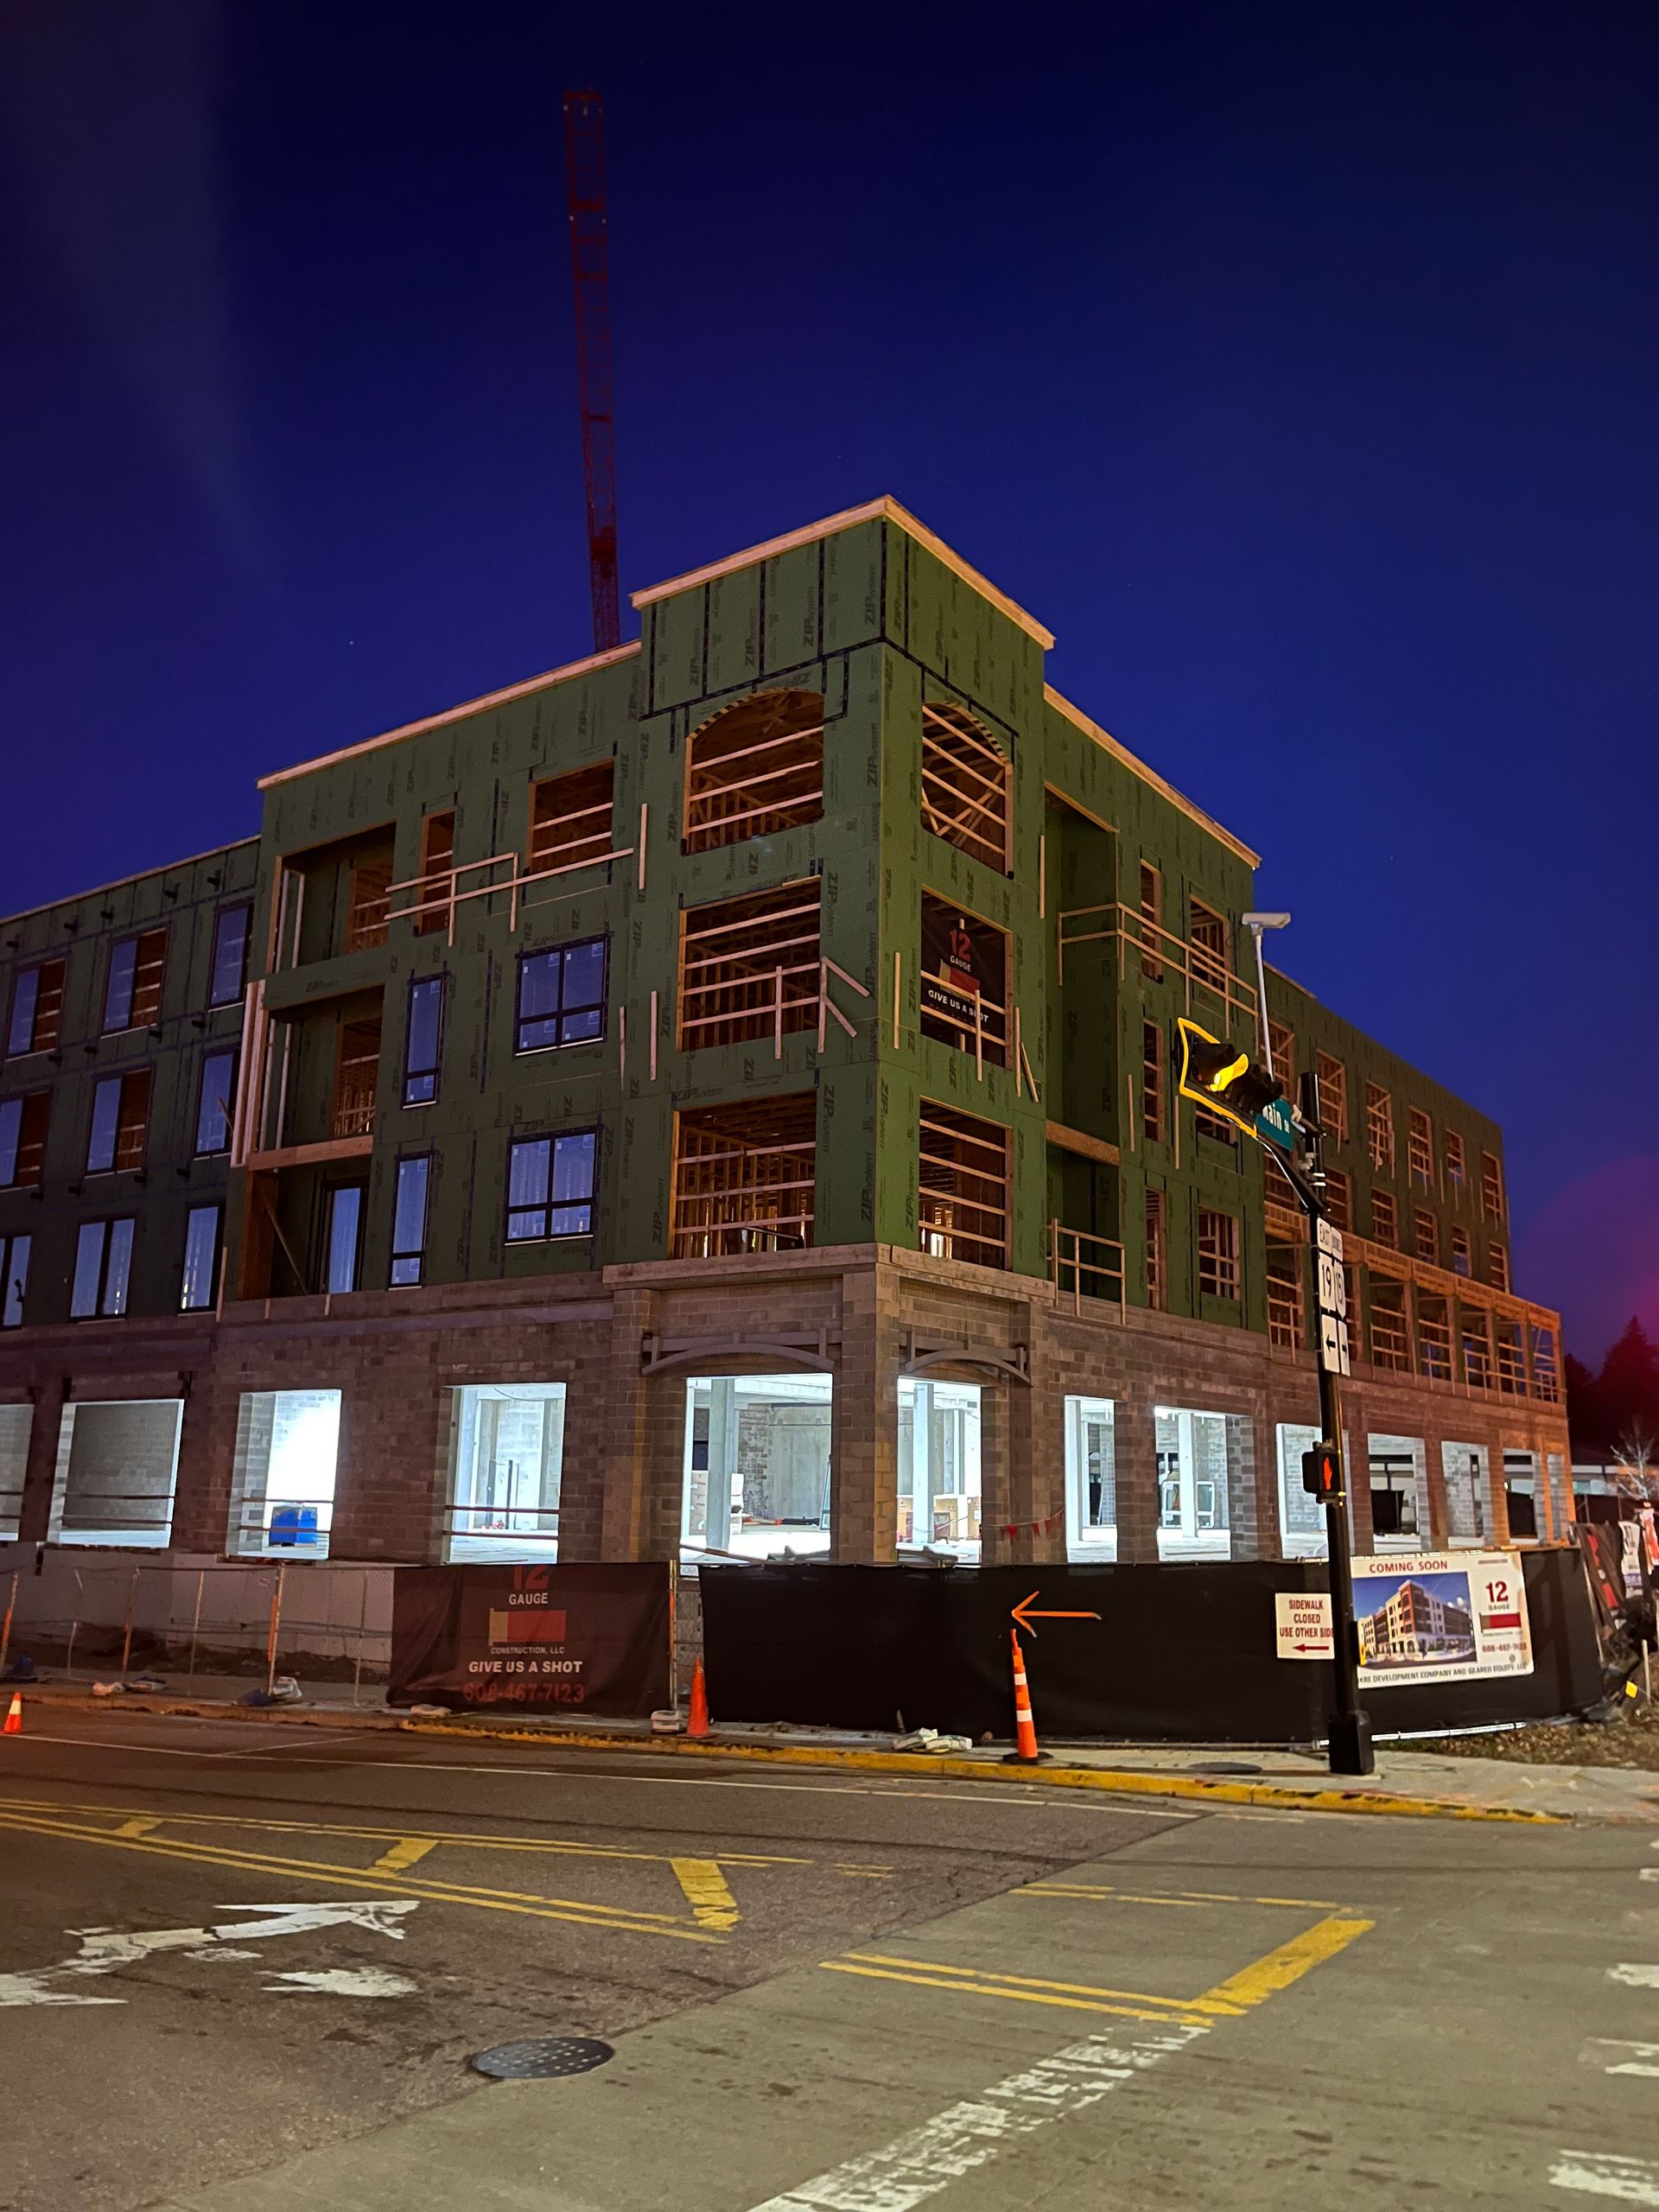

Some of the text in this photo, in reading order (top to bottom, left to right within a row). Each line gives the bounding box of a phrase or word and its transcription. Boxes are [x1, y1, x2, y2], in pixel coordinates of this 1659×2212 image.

[950, 929, 971, 962] 12
[950, 955, 972, 972] GAUGE
[928, 989, 948, 1004] GIVE
[950, 998, 961, 1010] US
[962, 1005, 968, 1014] A
[969, 1007, 989, 1023] SOT
[1321, 1264, 1332, 1298] 19
[1370, 1560, 1448, 1573] COMING SOON
[514, 1565, 550, 1590] 12
[509, 1592, 549, 1605] GAUGE
[1485, 1580, 1509, 1604] 12
[1288, 1599, 1324, 1610] SIDEWALK
[1294, 1614, 1320, 1624] CLOSED
[1280, 1627, 1294, 1637] USE
[1295, 1628, 1318, 1637] OTHER
[468, 1661, 583, 1674] GIVE US A SHOT
[1373, 1672, 1419, 1682] DEVELOPMENT
[1420, 1669, 1452, 1679] COMPANY
